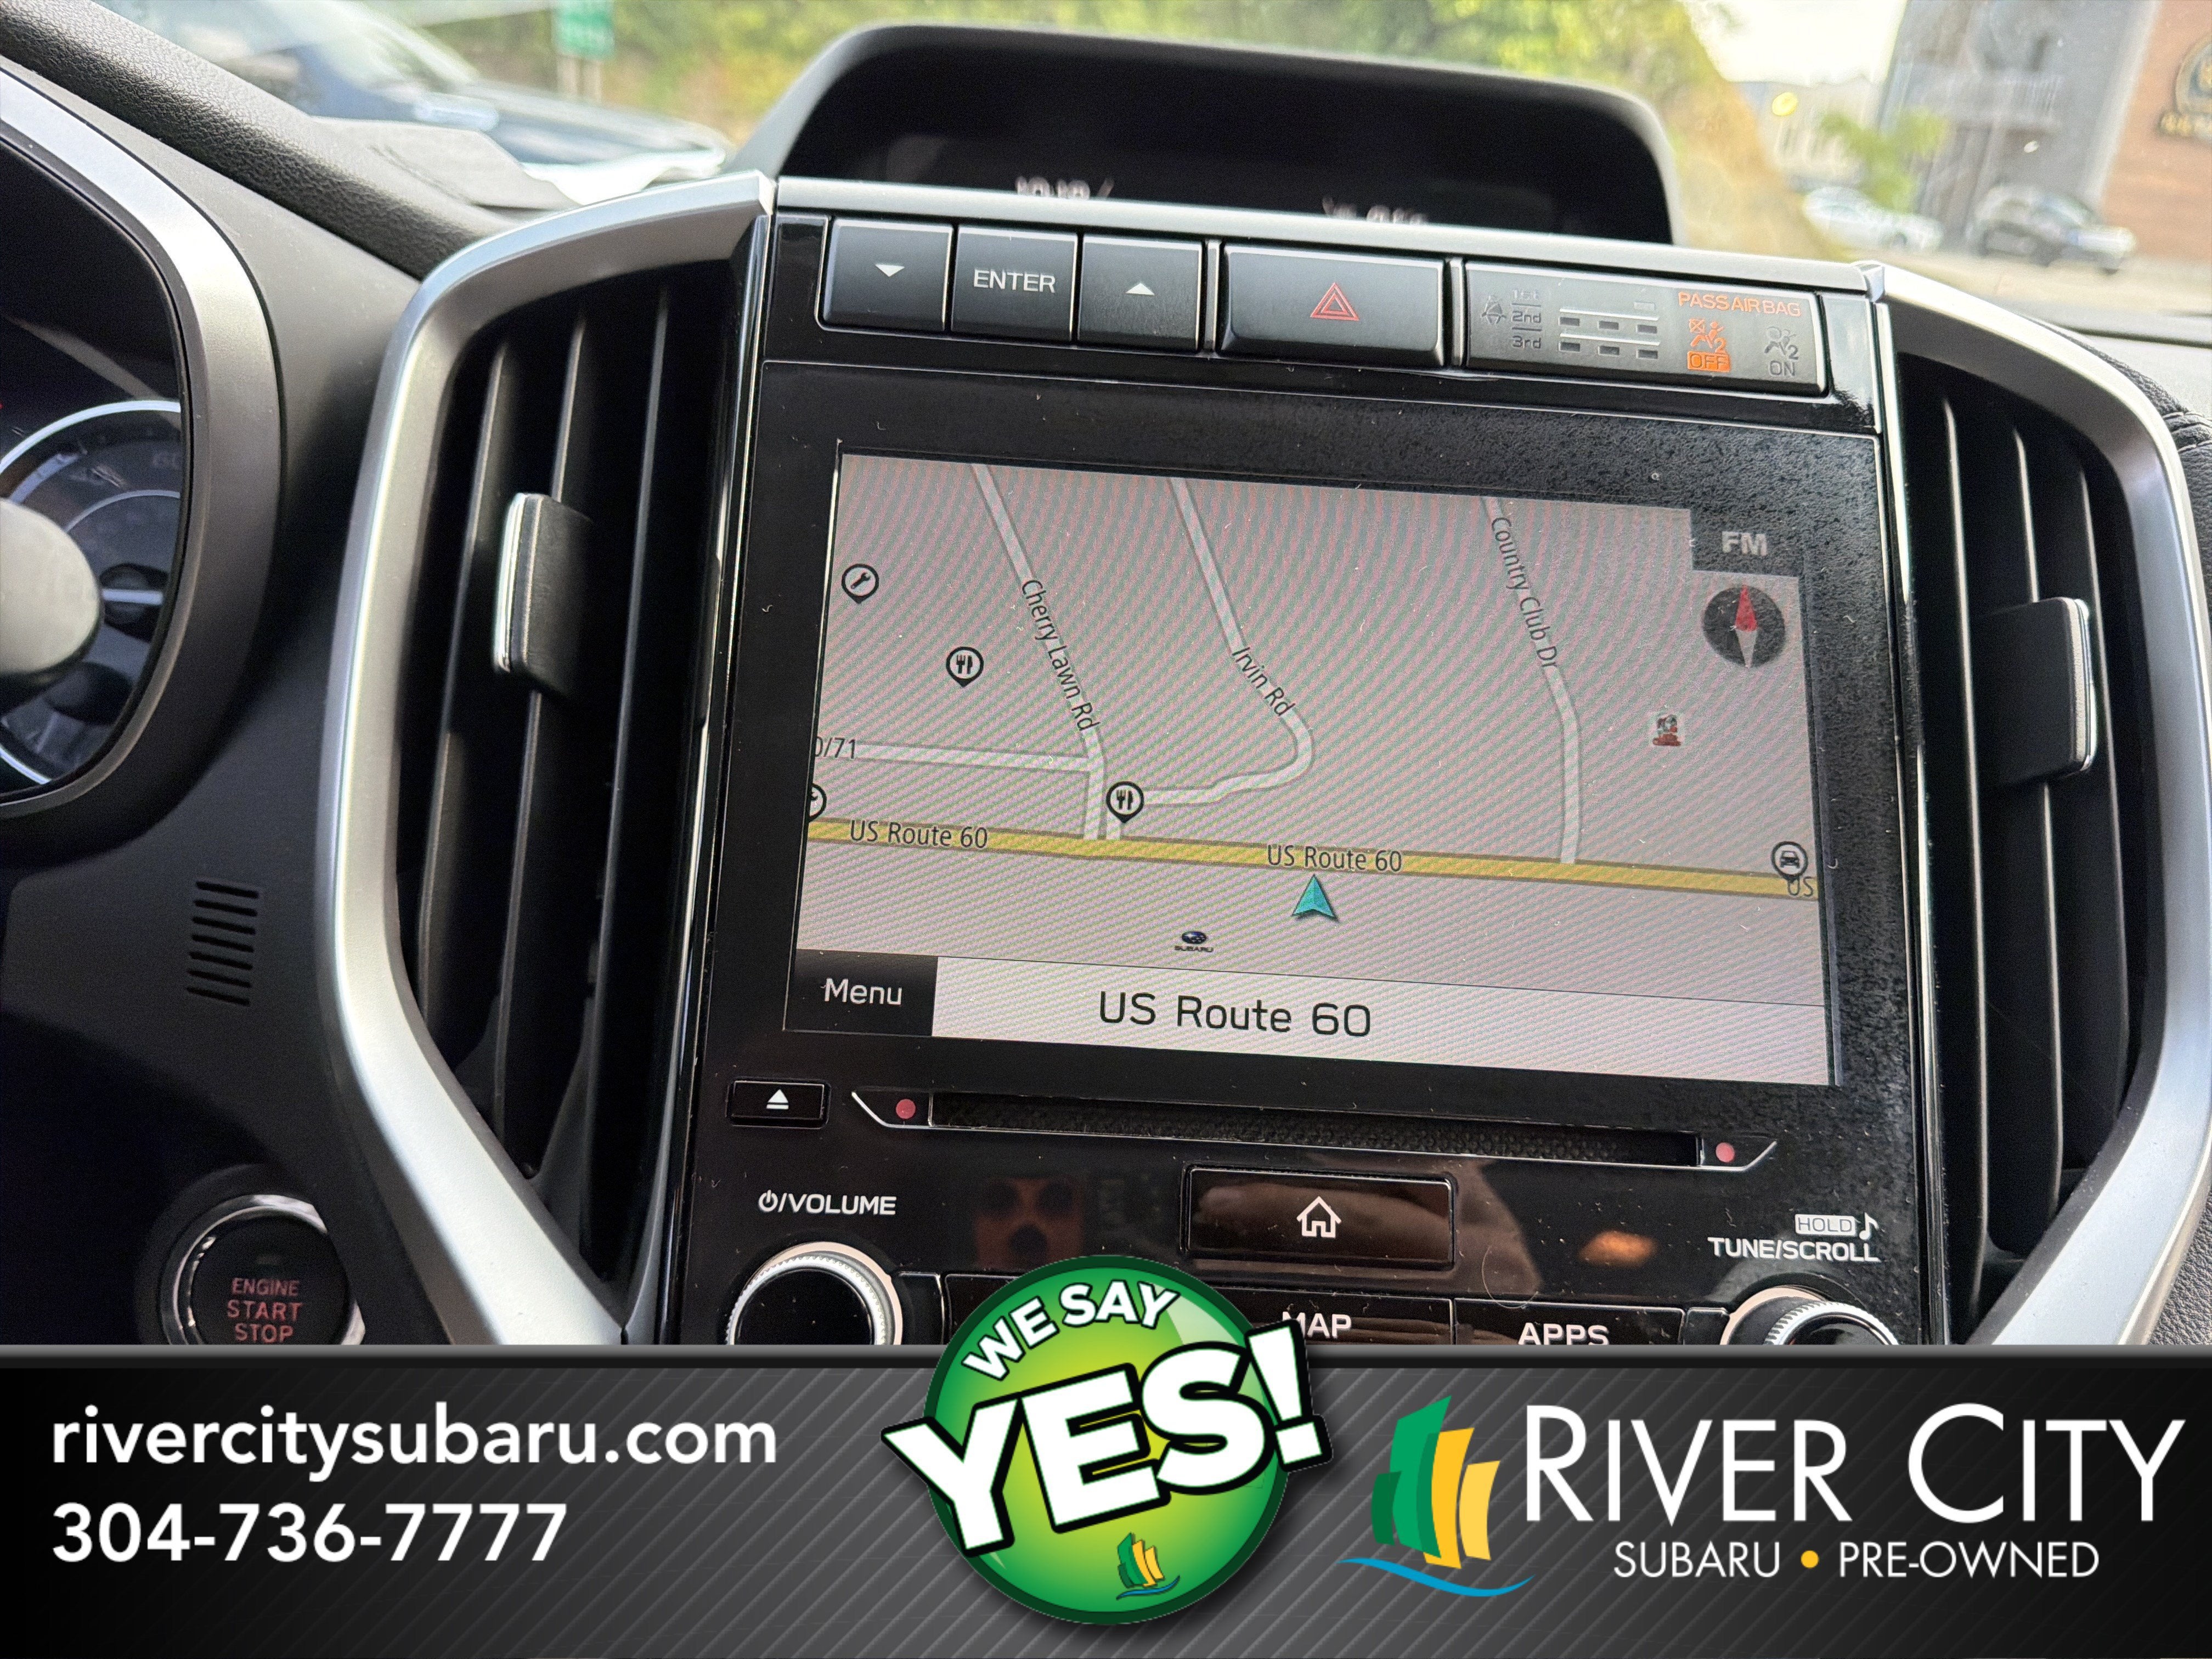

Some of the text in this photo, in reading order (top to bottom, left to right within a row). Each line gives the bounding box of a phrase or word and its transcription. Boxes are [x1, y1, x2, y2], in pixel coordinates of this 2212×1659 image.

[973, 268, 1056, 294] ENTER
[1678, 291, 1730, 311] PASS
[1513, 311, 1541, 323] 2nd
[1513, 335, 1541, 349] 3rd
[1690, 353, 1728, 370] OFF
[1769, 360, 1796, 376] ON
[1722, 531, 1767, 556] FM
[1492, 517, 1558, 667] Country Club Dr
[1022, 580, 1101, 731] Cherry Lawn Rd
[1232, 647, 1296, 716] Irvin Rd
[850, 819, 988, 848] US Route 60
[1267, 844, 1402, 872] US Route 60
[824, 978, 902, 1005] Menu
[1099, 991, 1371, 1037] US Route 60
[1797, 1217, 1853, 1232] HOLD
[1707, 1237, 1881, 1262] TUNE/SCROLL
[232, 1278, 300, 1296] ENGINE
[227, 1300, 303, 1321] START
[234, 1324, 294, 1343] STOP
[1517, 1322, 1610, 1345] APPS
